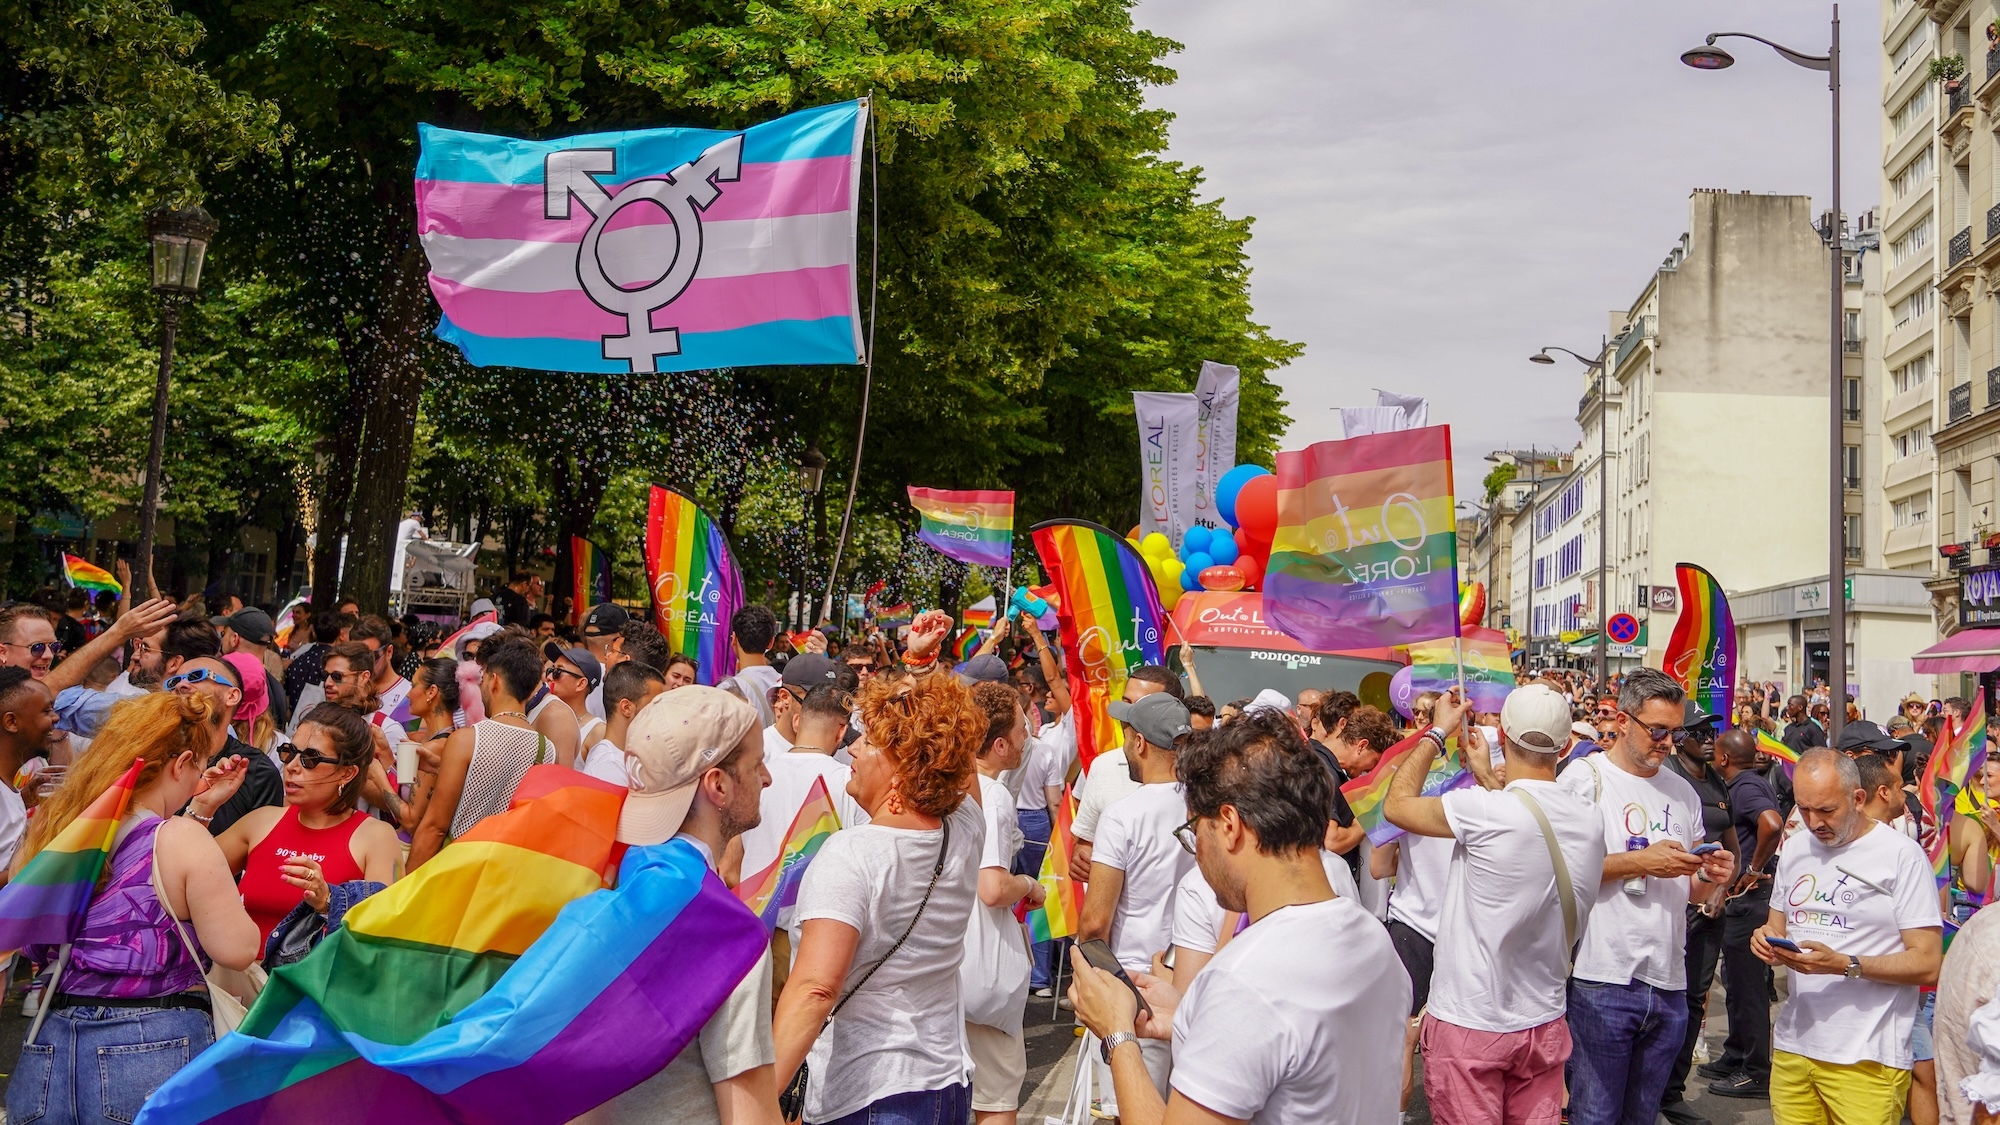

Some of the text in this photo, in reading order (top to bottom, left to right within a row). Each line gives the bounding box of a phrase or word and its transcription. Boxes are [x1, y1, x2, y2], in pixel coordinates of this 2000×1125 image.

[1147, 415, 1168, 522] L'ORÉAL
[1208, 627, 1254, 635] LGBTQIA+
[1250, 651, 1322, 665] PODIOCOM
[1787, 909, 1855, 930] L'ORÉAL
